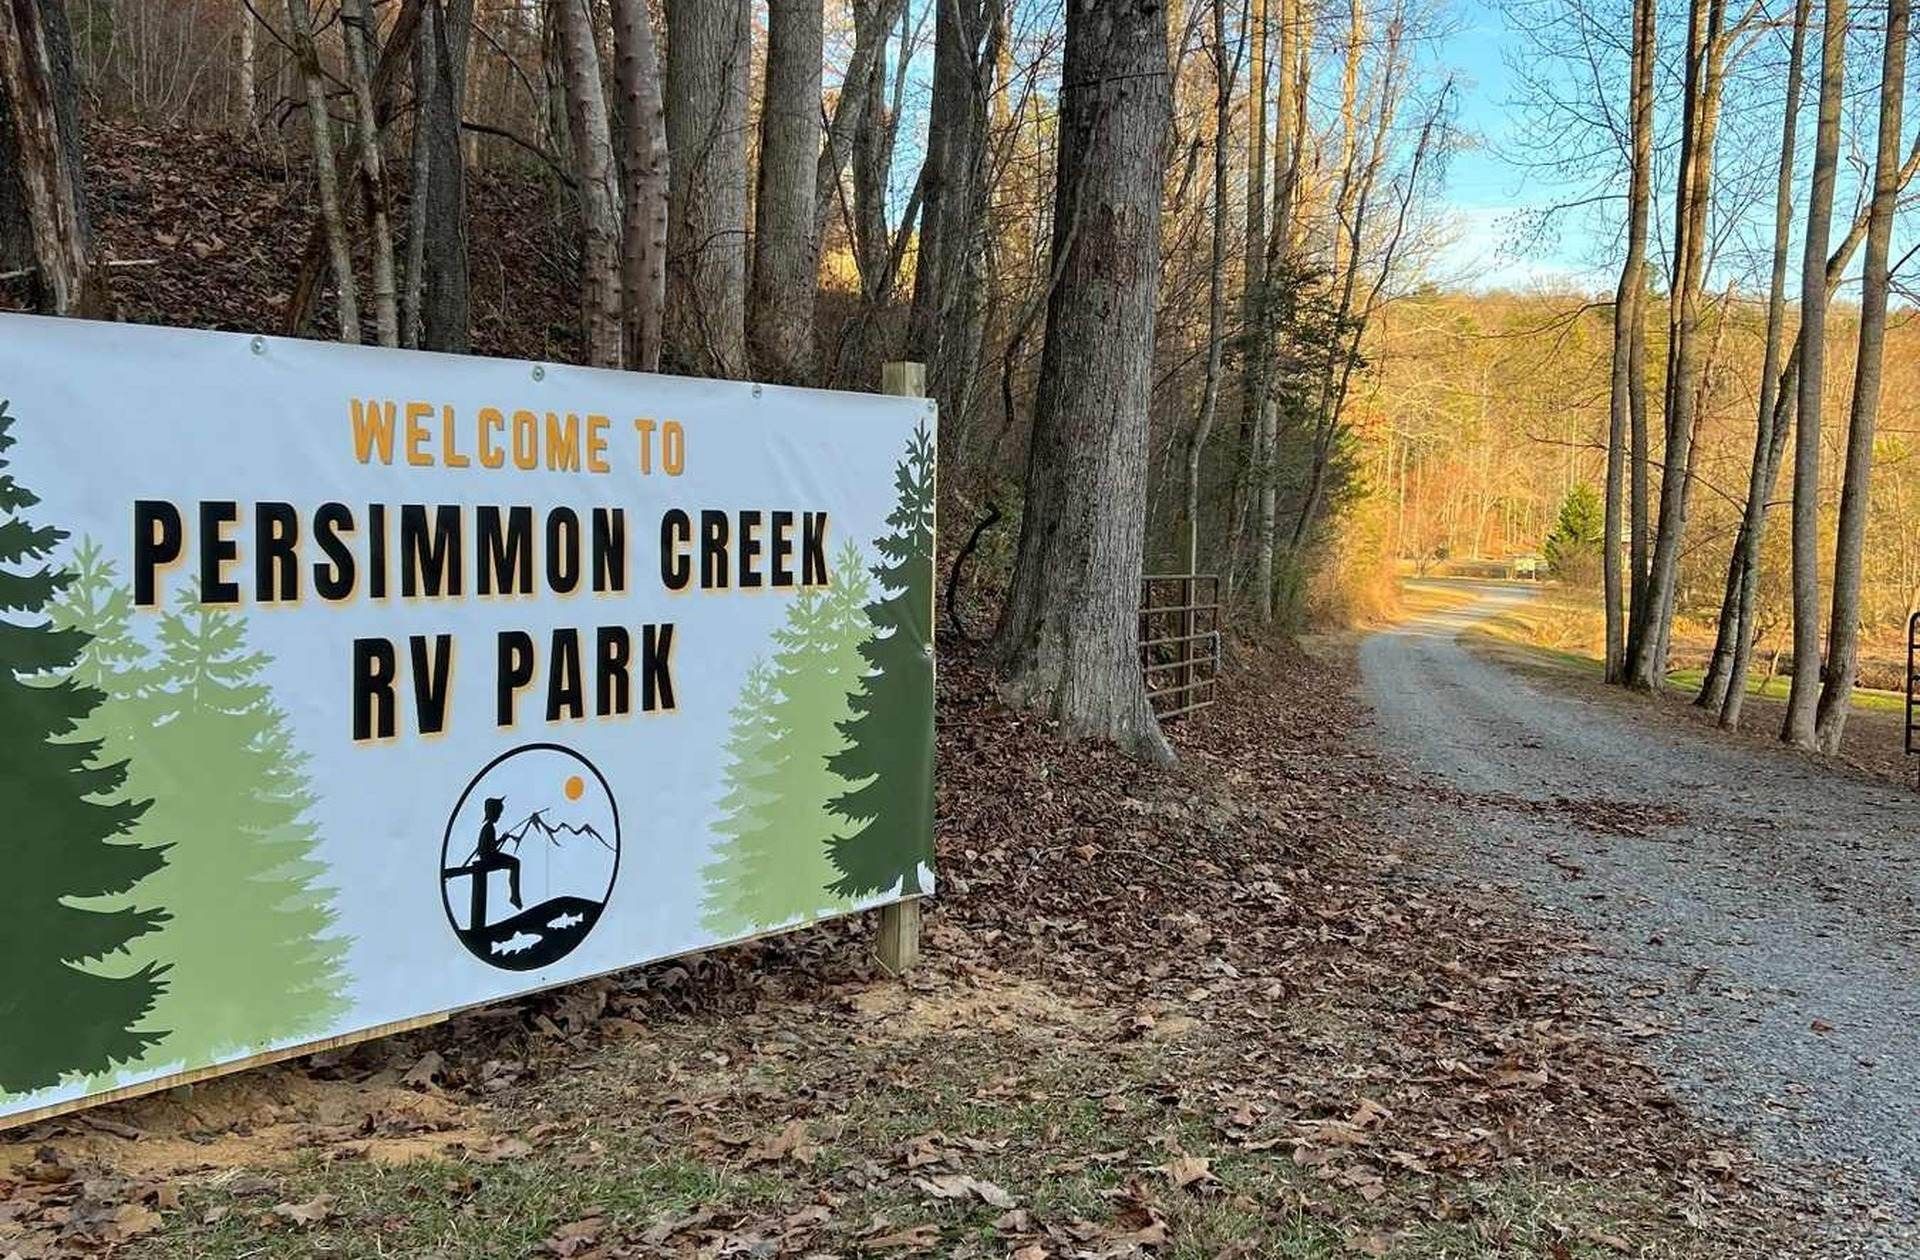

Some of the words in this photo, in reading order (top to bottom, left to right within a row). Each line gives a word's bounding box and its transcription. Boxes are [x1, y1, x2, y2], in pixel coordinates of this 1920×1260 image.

[350, 398, 610, 473] WELCOME
[634, 418, 686, 477] TO
[133, 499, 628, 606] PERSIMMON
[659, 508, 831, 591] CREEK
[351, 634, 455, 742] RV
[496, 623, 678, 728] PARK
